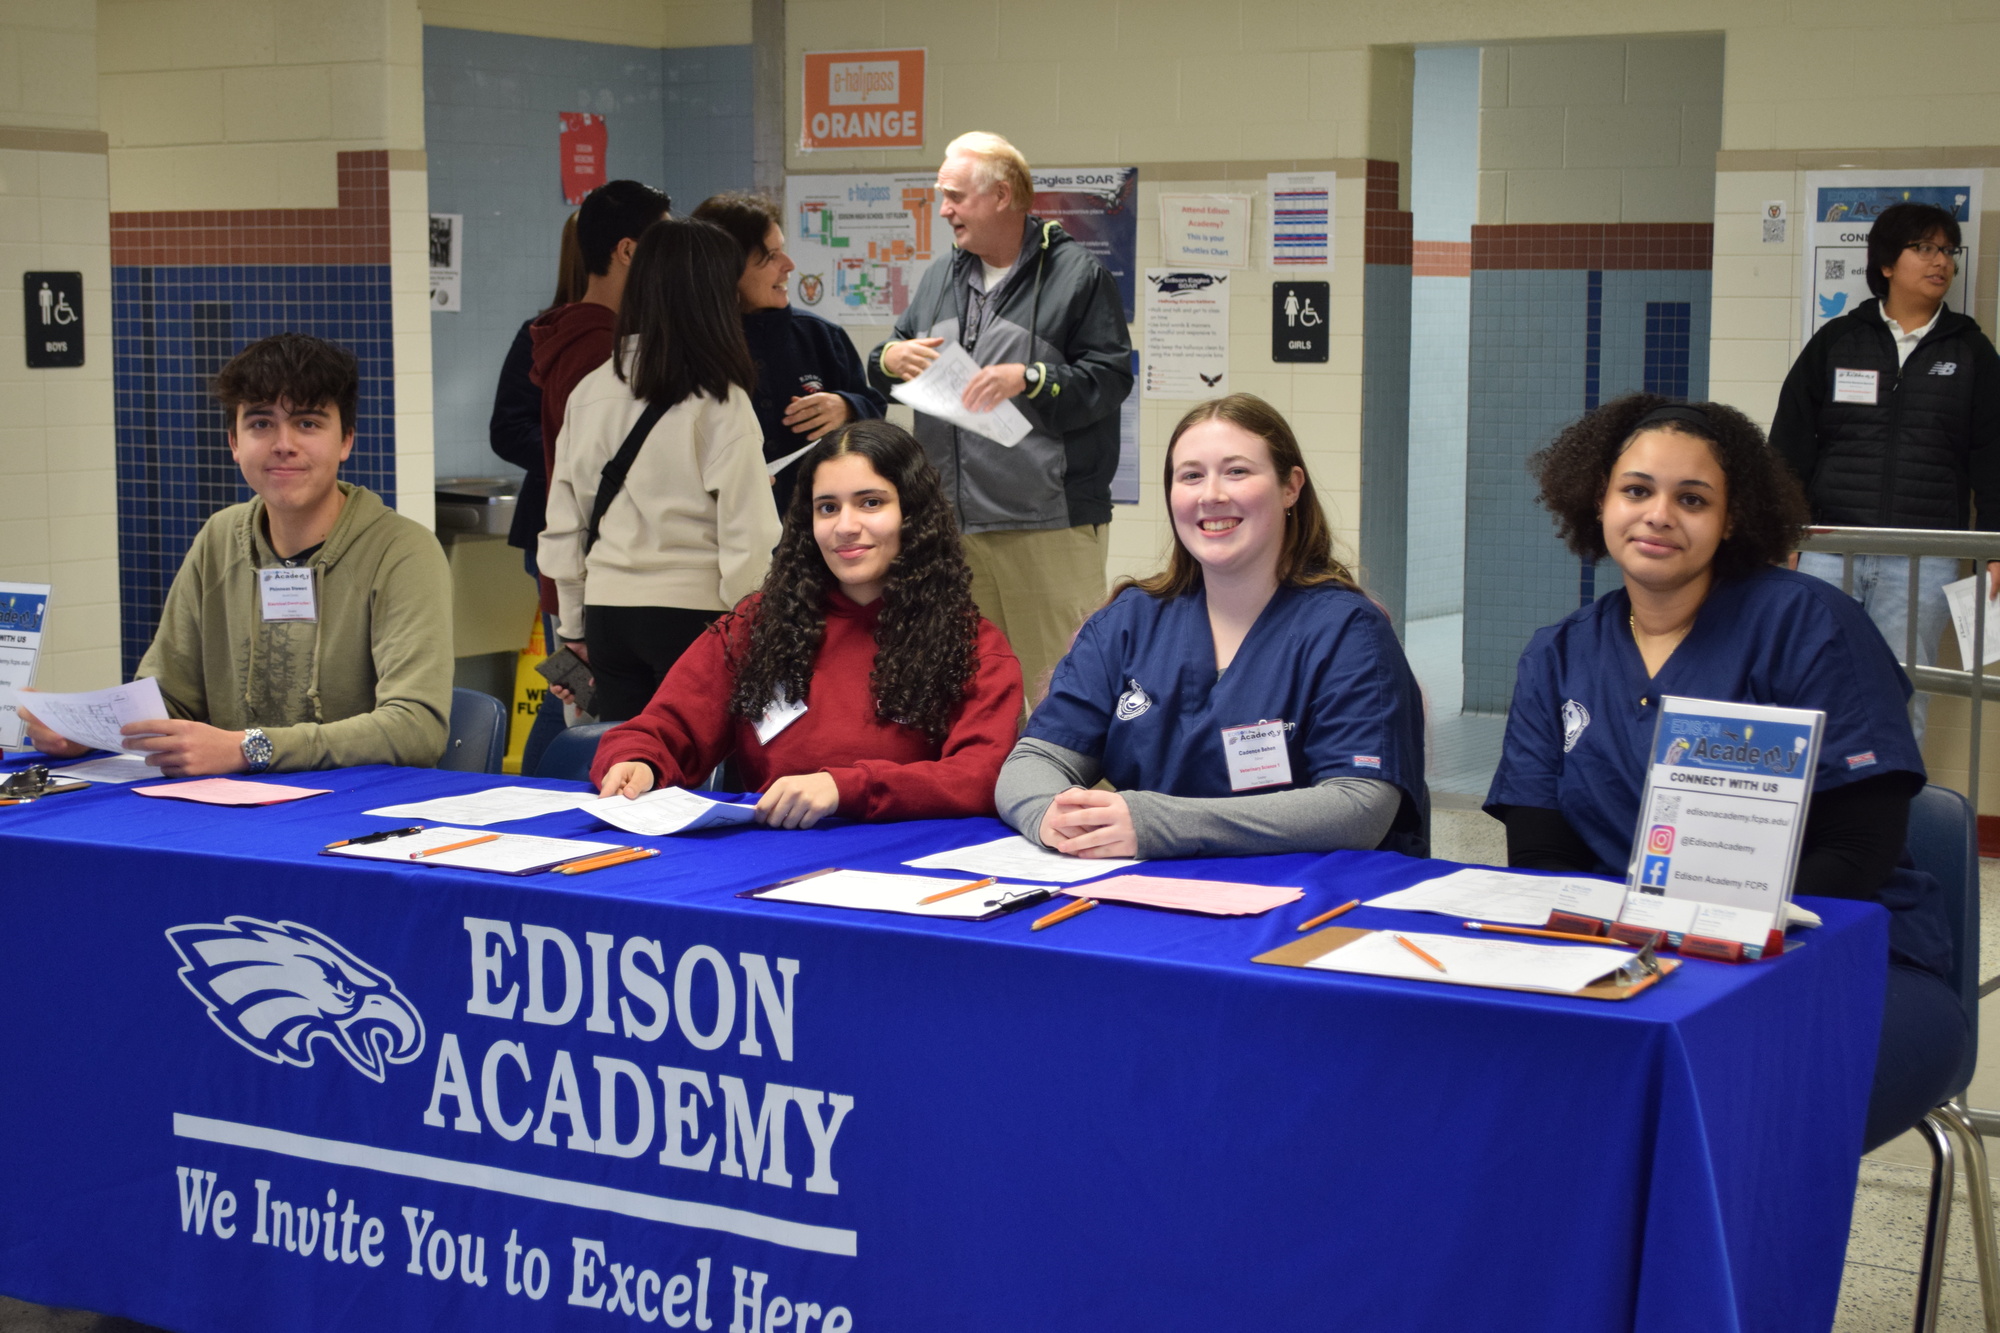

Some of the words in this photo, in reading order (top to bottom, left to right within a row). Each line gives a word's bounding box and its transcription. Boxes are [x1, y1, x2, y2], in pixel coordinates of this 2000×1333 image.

[811, 111, 917, 139] ORANGE
[1032, 175, 1073, 187] Eagles
[1076, 175, 1114, 184] SOAR
[1181, 206, 1205, 214] Attend
[1207, 207, 1230, 215] Edison
[1188, 220, 1224, 229] Academy?
[1187, 233, 1201, 241] This
[1209, 235, 1225, 243] your
[1182, 246, 1209, 255] Shuttles
[1211, 247, 1229, 256] Chart
[45, 341, 68, 352] BOYS
[1288, 340, 1312, 350] GIRLS
[1240, 730, 1282, 741] Academy
[1670, 718, 1722, 738] EDISON
[1238, 748, 1260, 756] Cadence
[1693, 736, 1801, 774] Academy
[1670, 772, 1726, 787] CONNECT
[1729, 778, 1759, 791] WITH
[1762, 782, 1779, 793] US
[1680, 836, 1756, 855] @EdisonAcademy
[1674, 870, 1704, 882] Edison
[1705, 875, 1742, 890] Academy
[1744, 880, 1768, 891] FCPS
[463, 916, 800, 1062] EDISON
[423, 1033, 854, 1195] ACADEMY
[176, 1166, 237, 1239] We
[252, 1179, 386, 1267] Invite
[402, 1206, 488, 1288] You
[504, 1229, 550, 1300] to
[568, 1237, 713, 1331] Excel
[729, 1265, 853, 1333] Here
